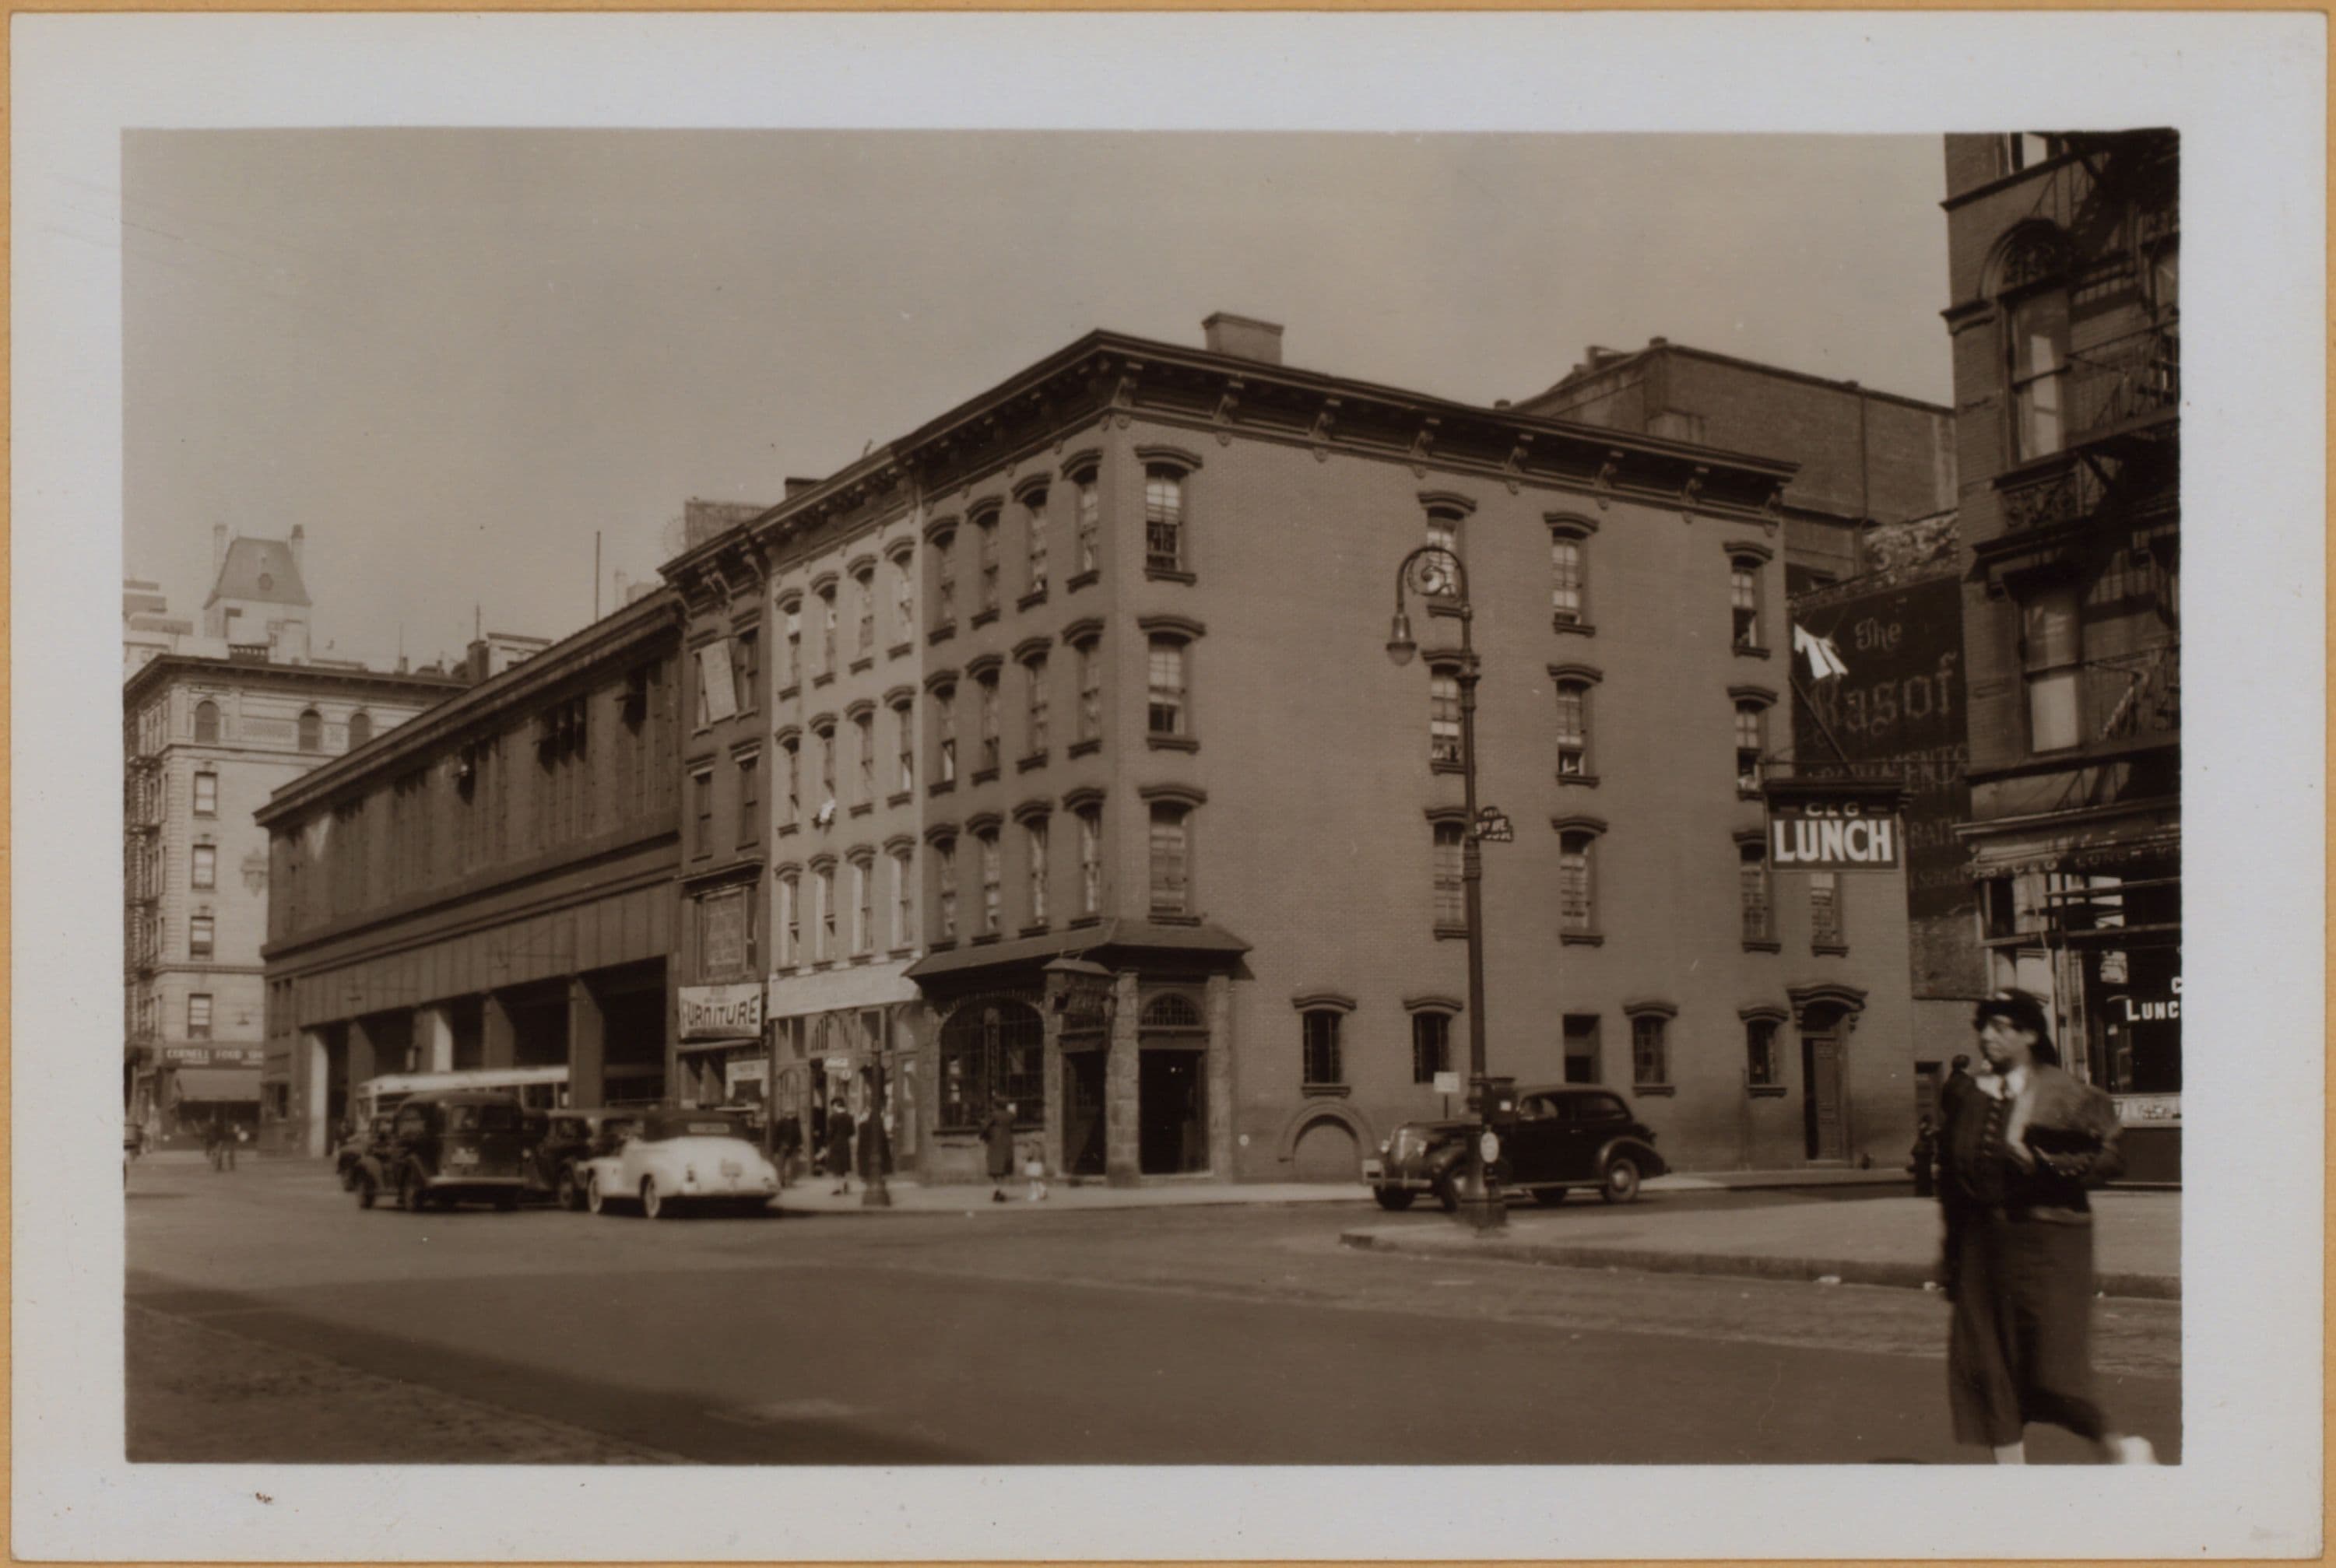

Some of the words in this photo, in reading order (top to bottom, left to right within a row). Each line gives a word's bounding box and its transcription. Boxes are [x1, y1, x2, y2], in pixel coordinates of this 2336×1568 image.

[1853, 616, 1902, 652] The
[1772, 819, 1893, 863] LUNCH
[680, 994, 761, 1027] FURNITURE
